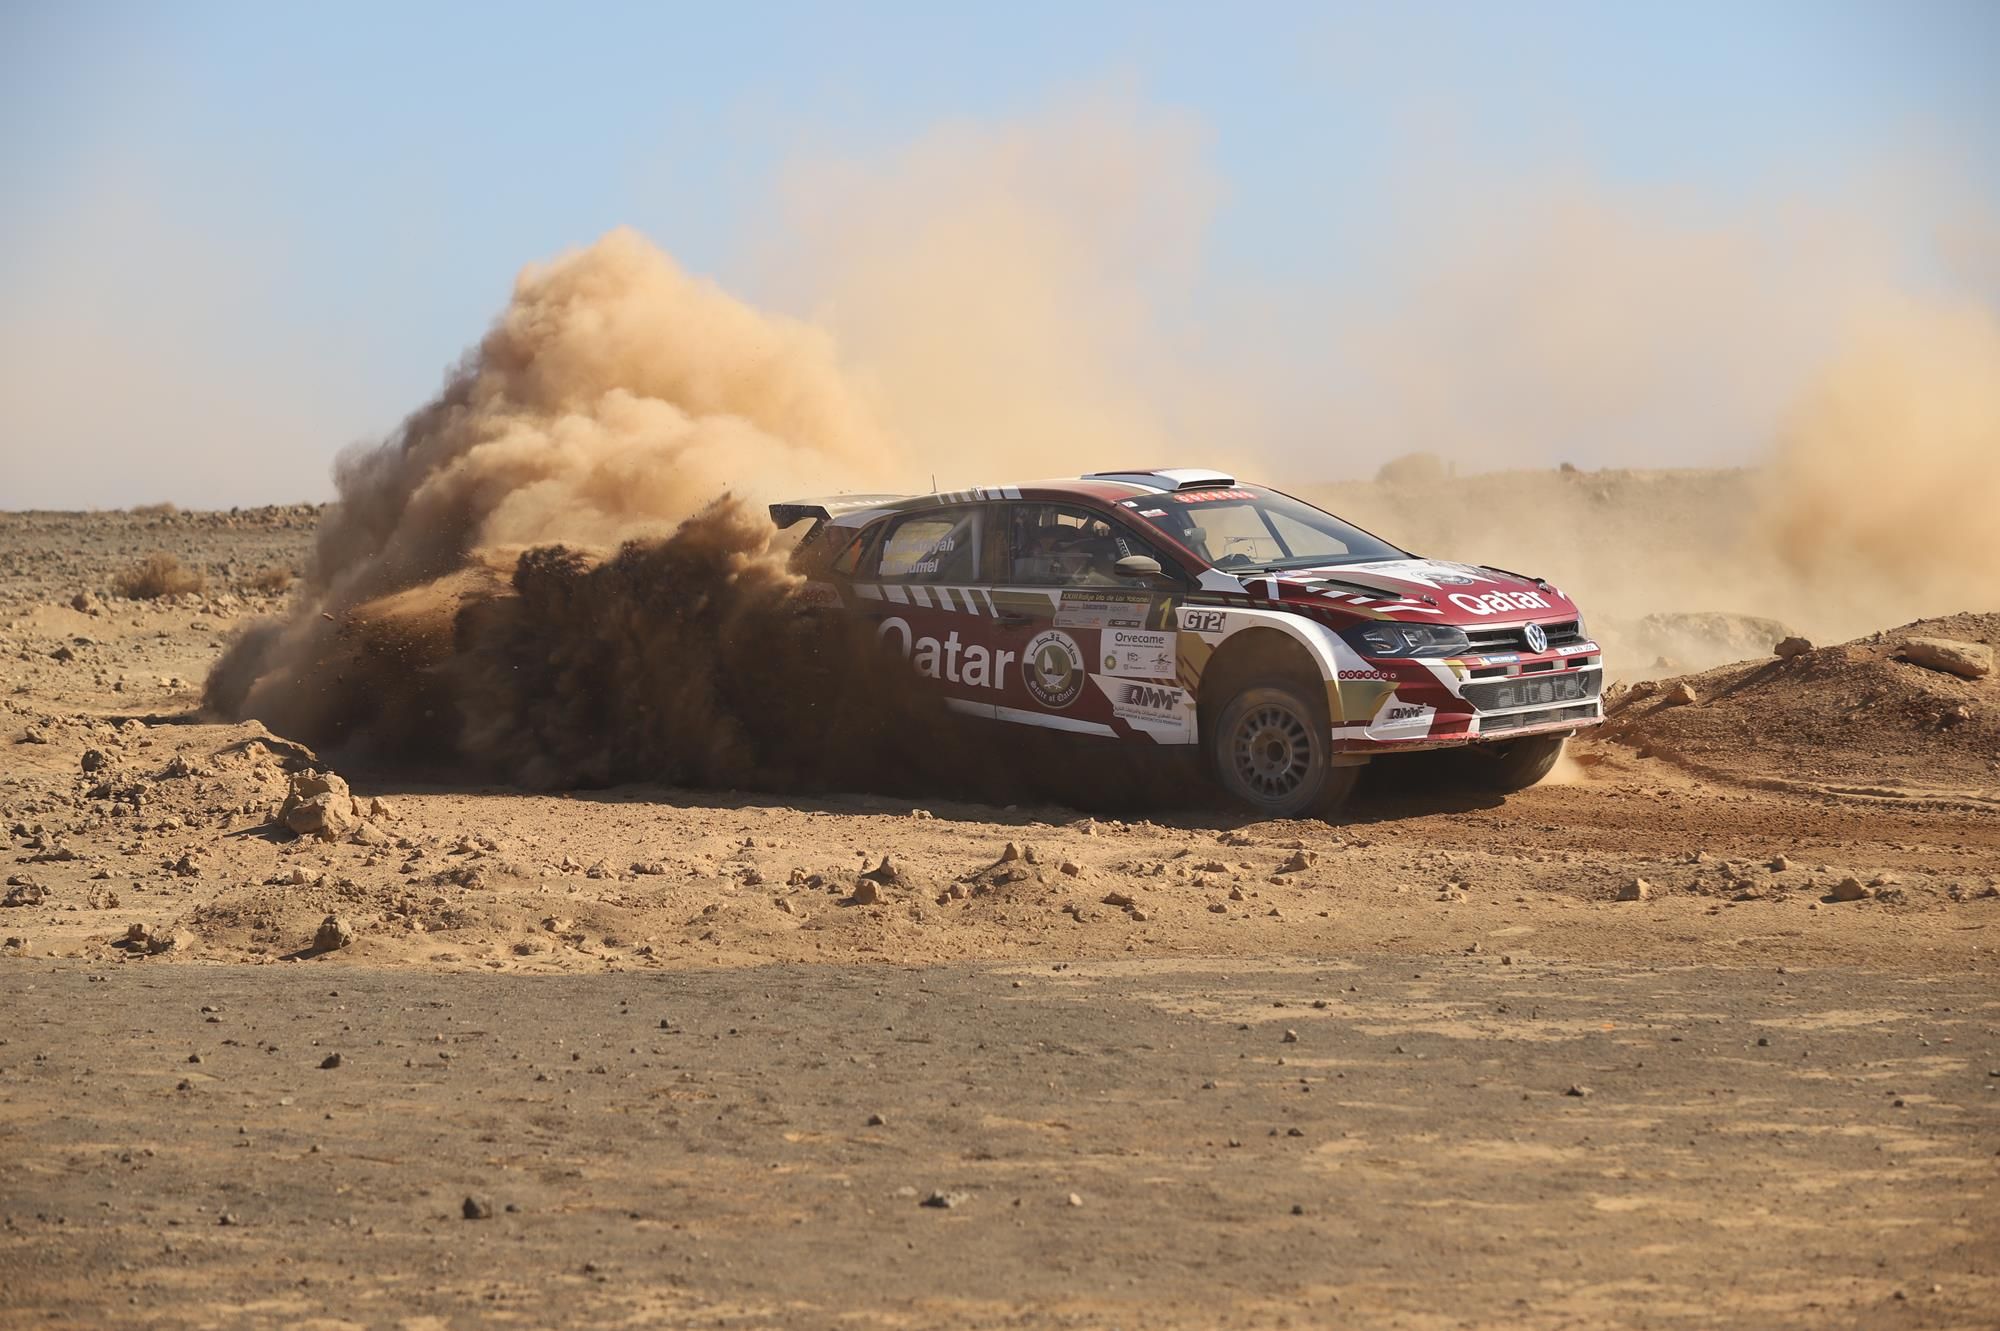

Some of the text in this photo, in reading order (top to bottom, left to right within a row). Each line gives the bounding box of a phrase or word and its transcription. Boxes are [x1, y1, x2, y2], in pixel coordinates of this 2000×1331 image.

[1159, 597, 1172, 630] 1
[1448, 590, 1551, 615] Qatar
[1184, 611, 1225, 632] GT2i
[1115, 632, 1165, 645] Orvecame
[878, 616, 1015, 690] Qatar
[1338, 670, 1397, 679] ooredoo
[1498, 671, 1588, 708] autotek
